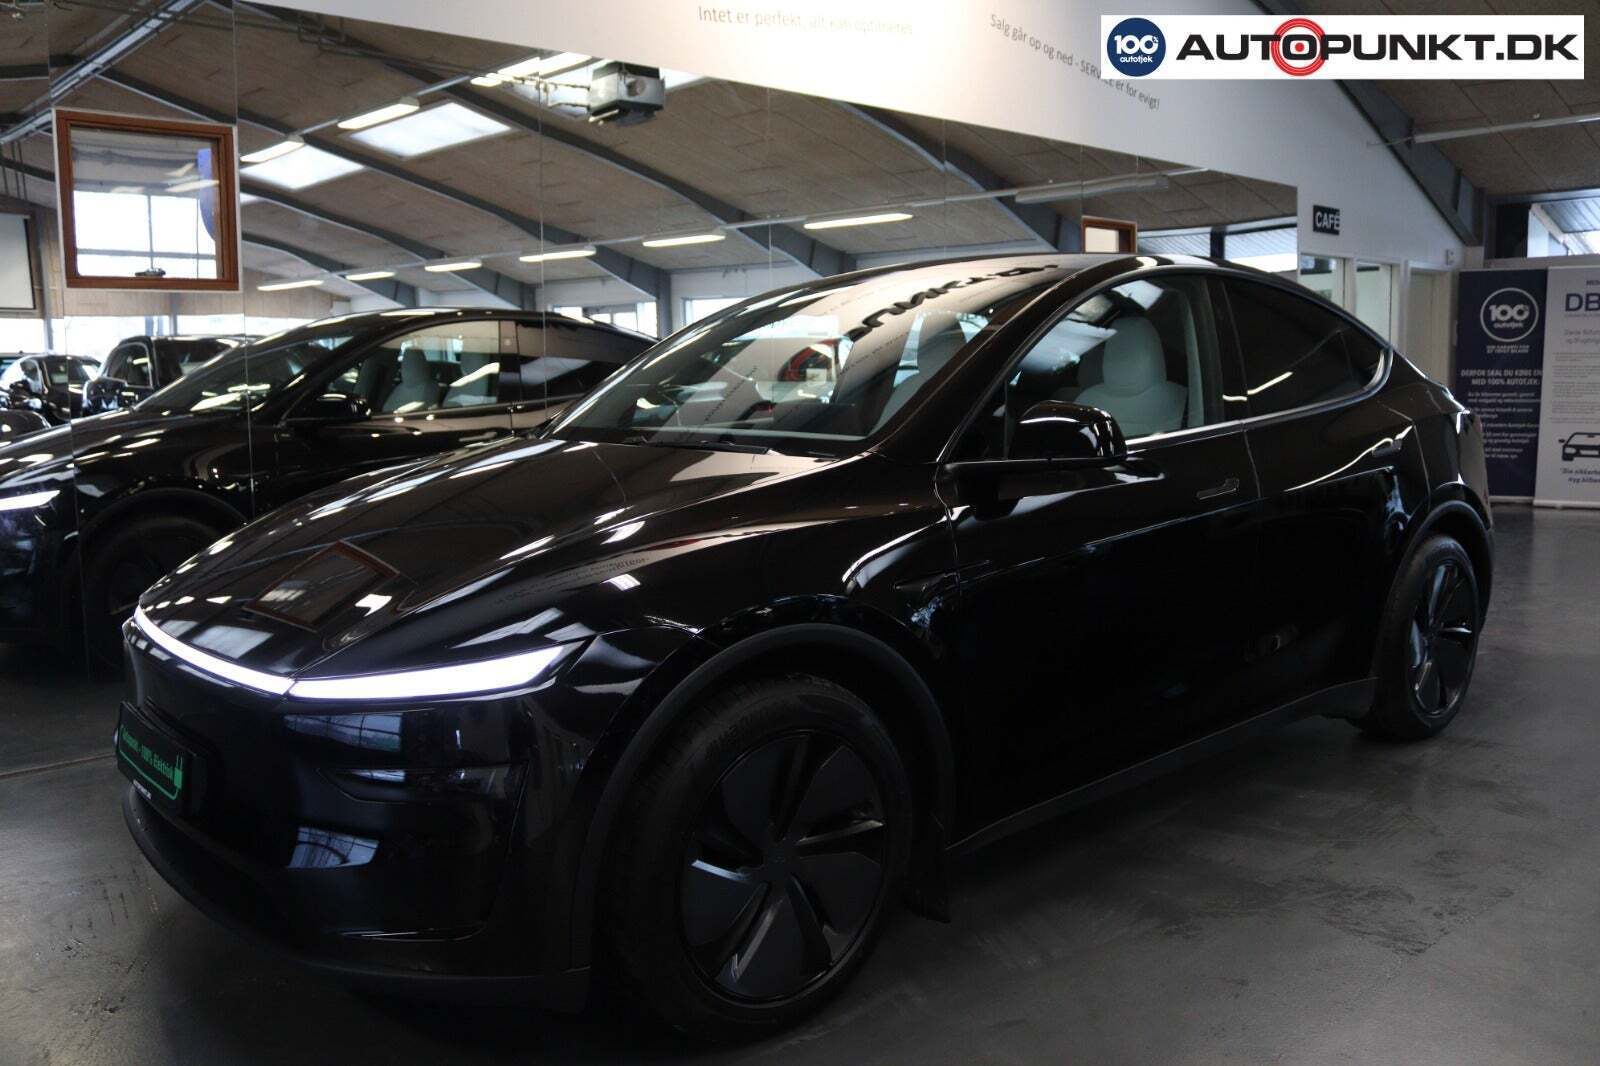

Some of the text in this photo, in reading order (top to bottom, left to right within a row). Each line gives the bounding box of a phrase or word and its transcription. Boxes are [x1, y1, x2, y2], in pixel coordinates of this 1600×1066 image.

[698, 6, 732, 23] Intet
[737, 11, 749, 24] er
[990, 14, 1010, 37] Salg
[1011, 27, 1027, 42] går
[1029, 35, 1041, 50] op
[1043, 44, 1055, 60] og
[1057, 50, 1074, 66] ned
[1115, 79, 1125, 91] er
[1126, 82, 1138, 98] for
[1315, 211, 1341, 230] CAFÉ
